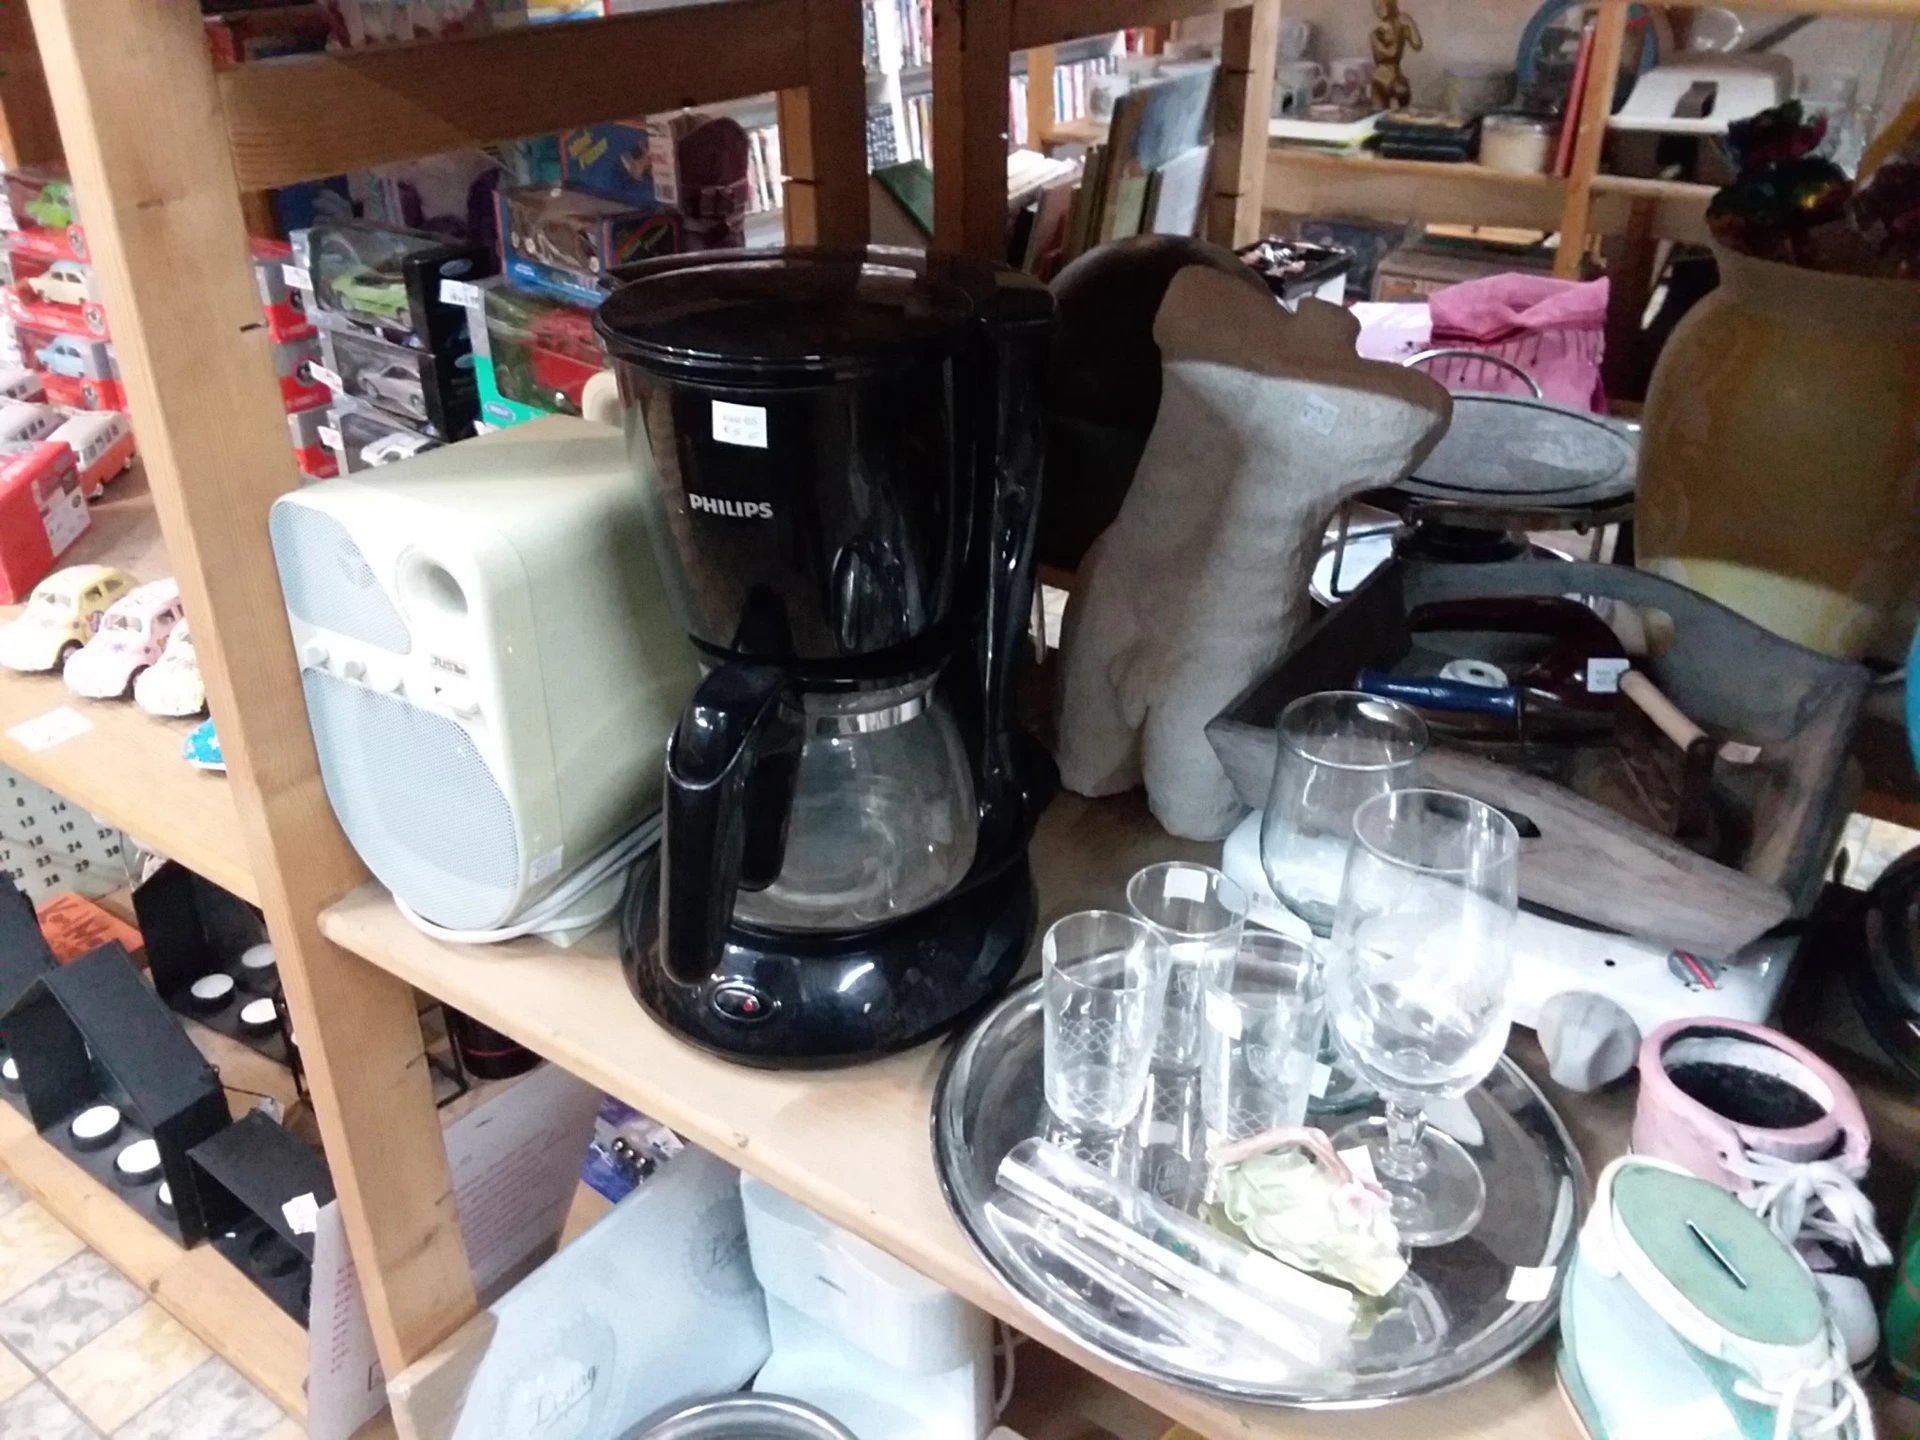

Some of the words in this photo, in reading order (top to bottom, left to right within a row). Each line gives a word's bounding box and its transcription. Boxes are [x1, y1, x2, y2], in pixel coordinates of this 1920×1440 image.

[689, 493, 774, 518] PHILIPS
[51, 801, 66, 815] 14
[67, 840, 82, 854] 24
